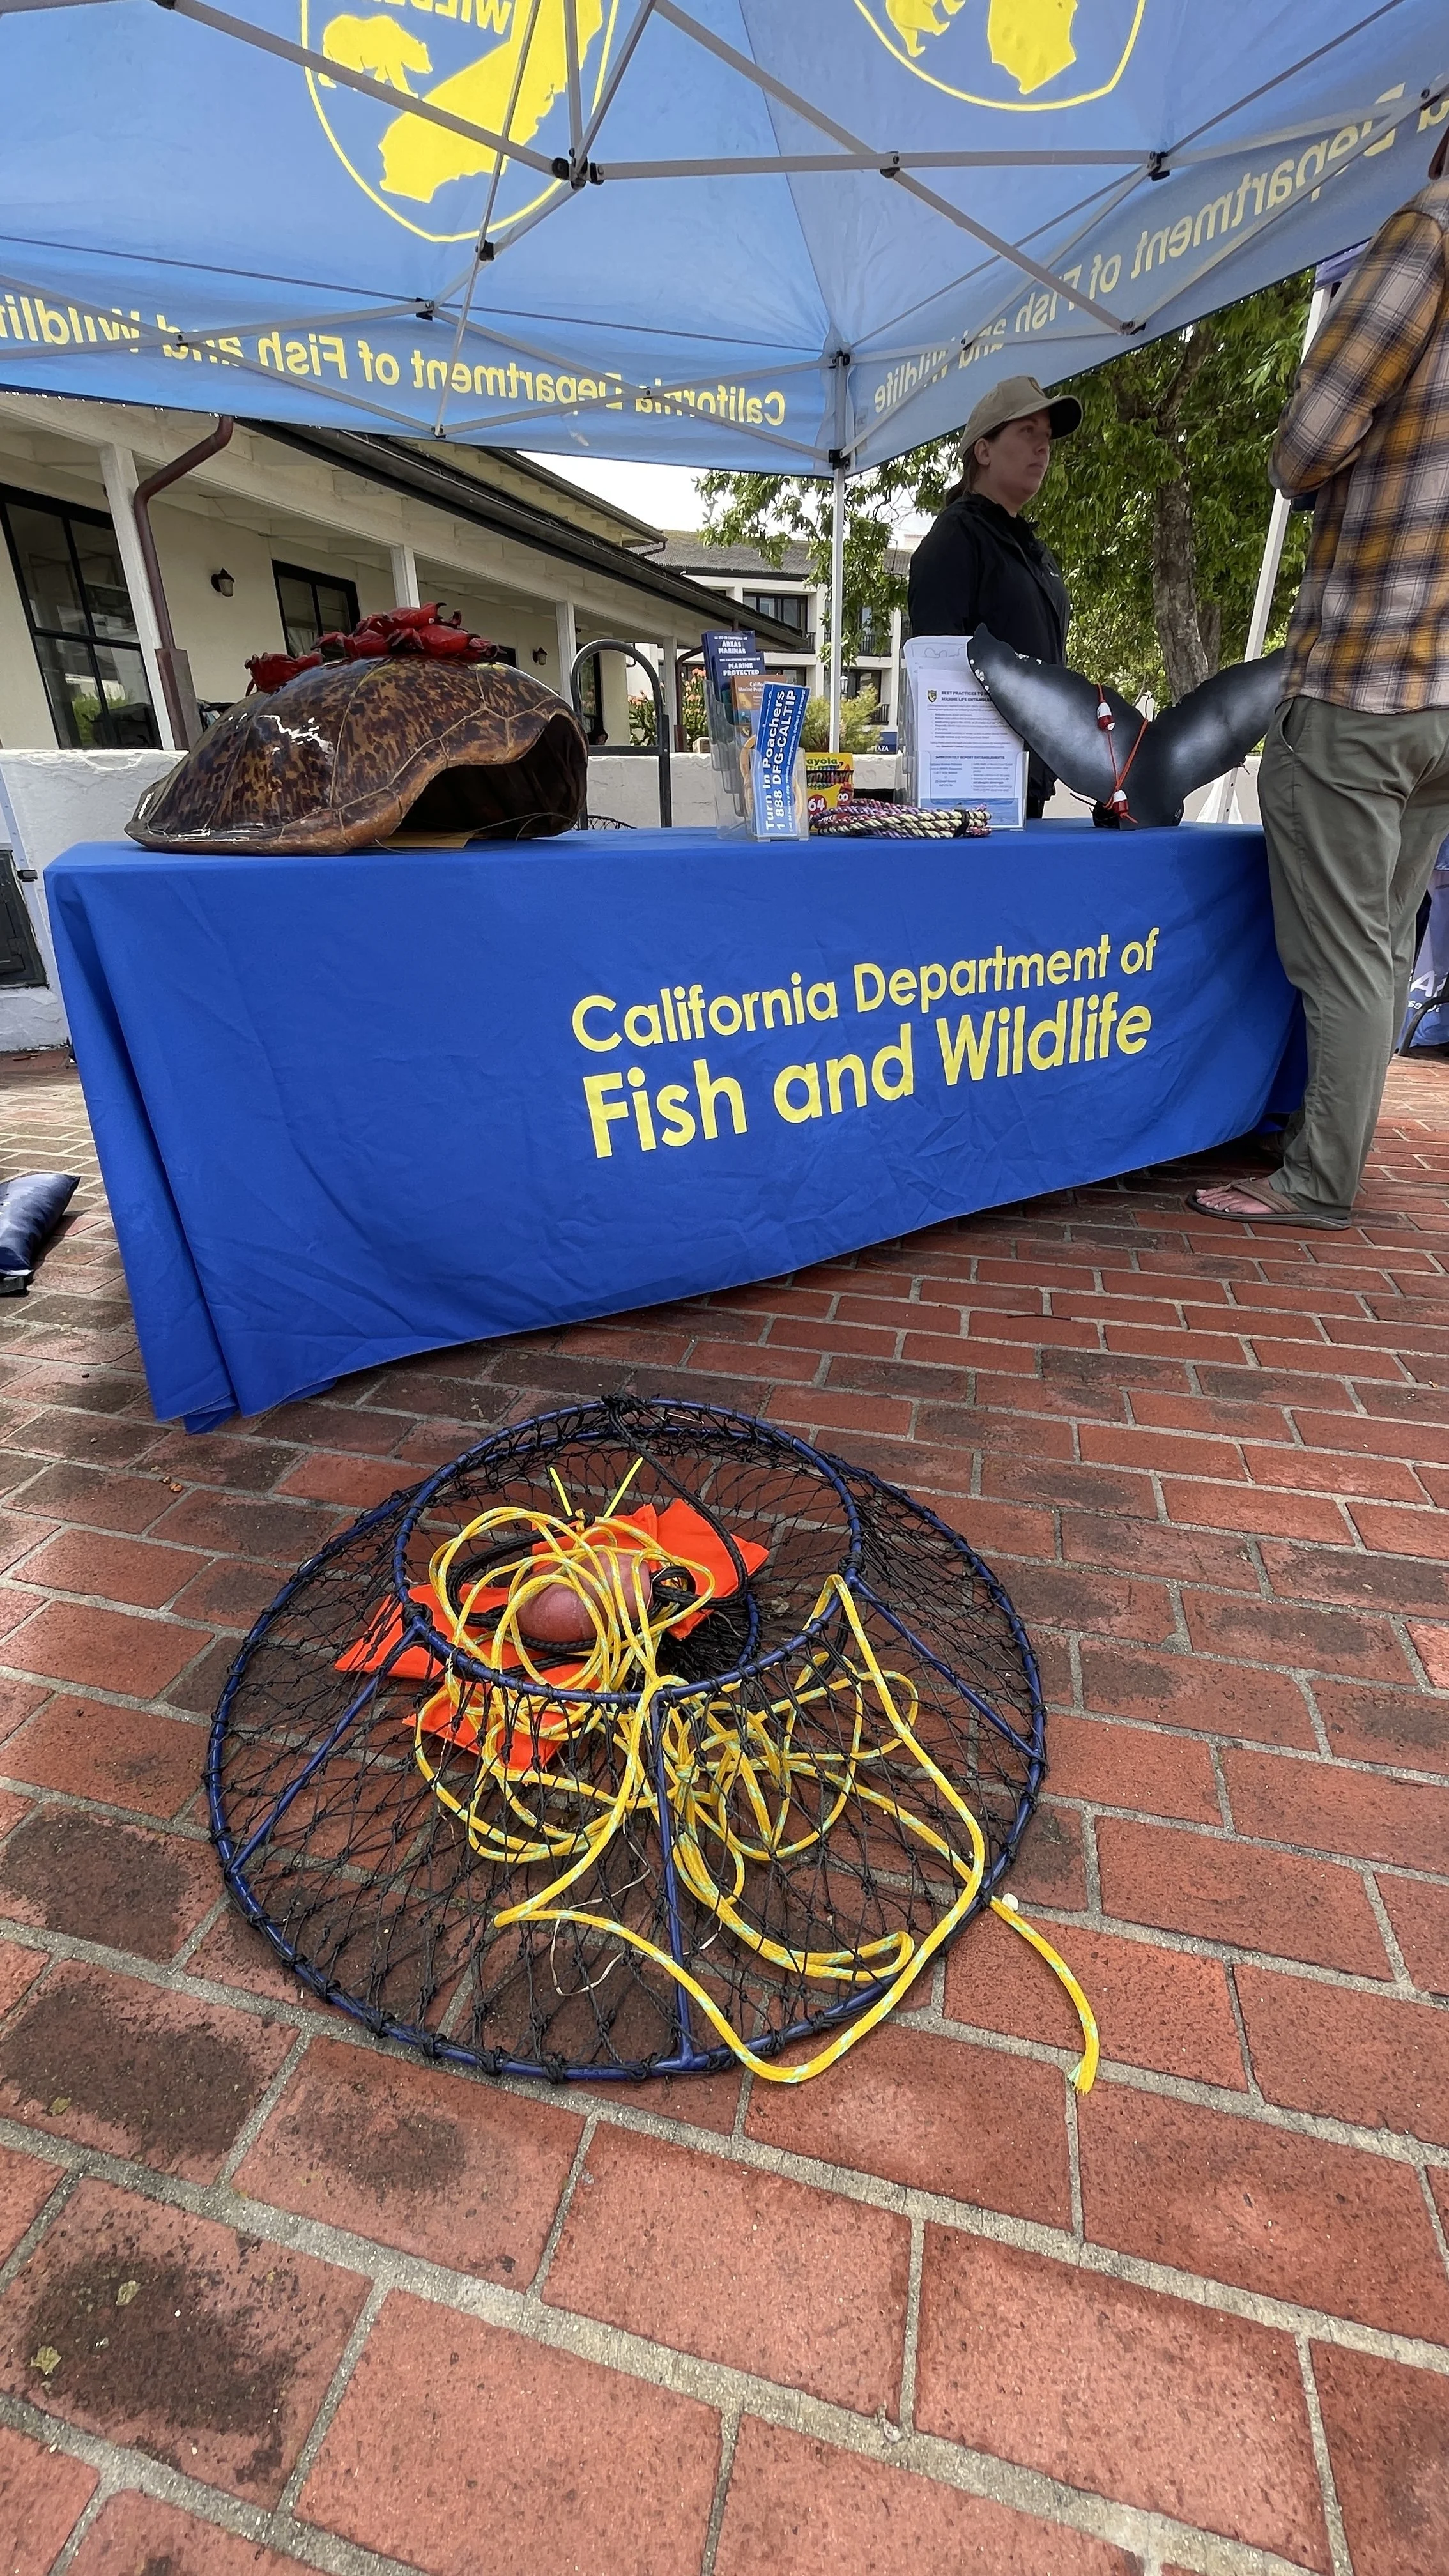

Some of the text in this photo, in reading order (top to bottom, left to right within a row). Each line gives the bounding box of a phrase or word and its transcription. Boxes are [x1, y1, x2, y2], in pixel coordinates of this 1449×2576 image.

[762, 691, 785, 769] Poachers
[772, 690, 796, 785] DFG-CALTIP
[806, 757, 838, 766] ayola
[762, 774, 771, 789] In
[765, 794, 775, 831] Turn
[774, 790, 785, 817] 888
[808, 798, 825, 811] 64
[572, 928, 1160, 1052] California Department of
[582, 992, 1151, 1159] Fish and Wildlife
